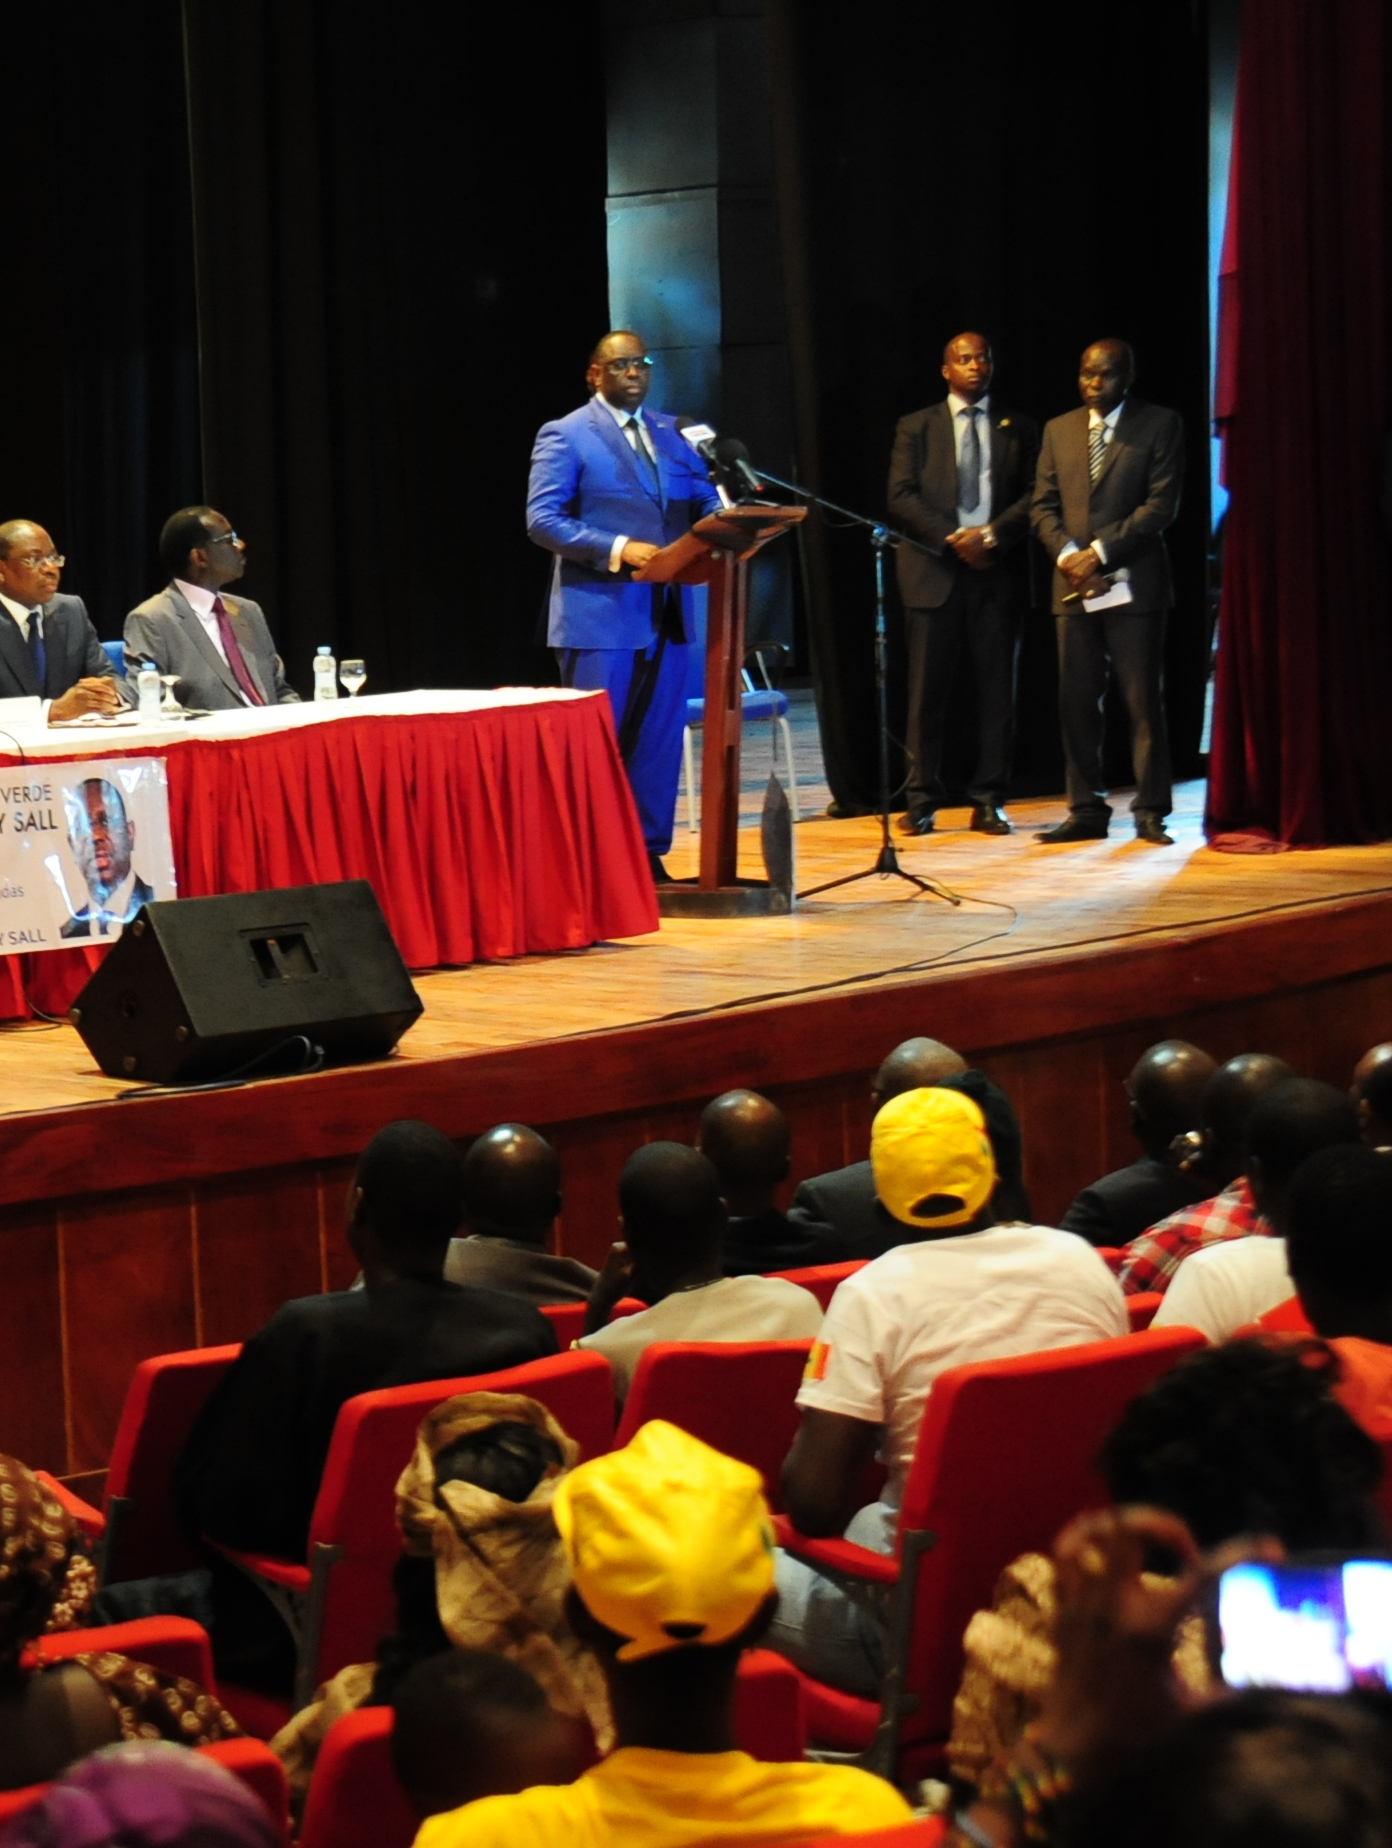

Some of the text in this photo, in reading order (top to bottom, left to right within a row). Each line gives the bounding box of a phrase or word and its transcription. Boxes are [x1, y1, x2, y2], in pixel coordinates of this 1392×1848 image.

[0, 784, 53, 804] VERDE
[13, 809, 58, 833] SALL
[8, 928, 47, 945] SALL
